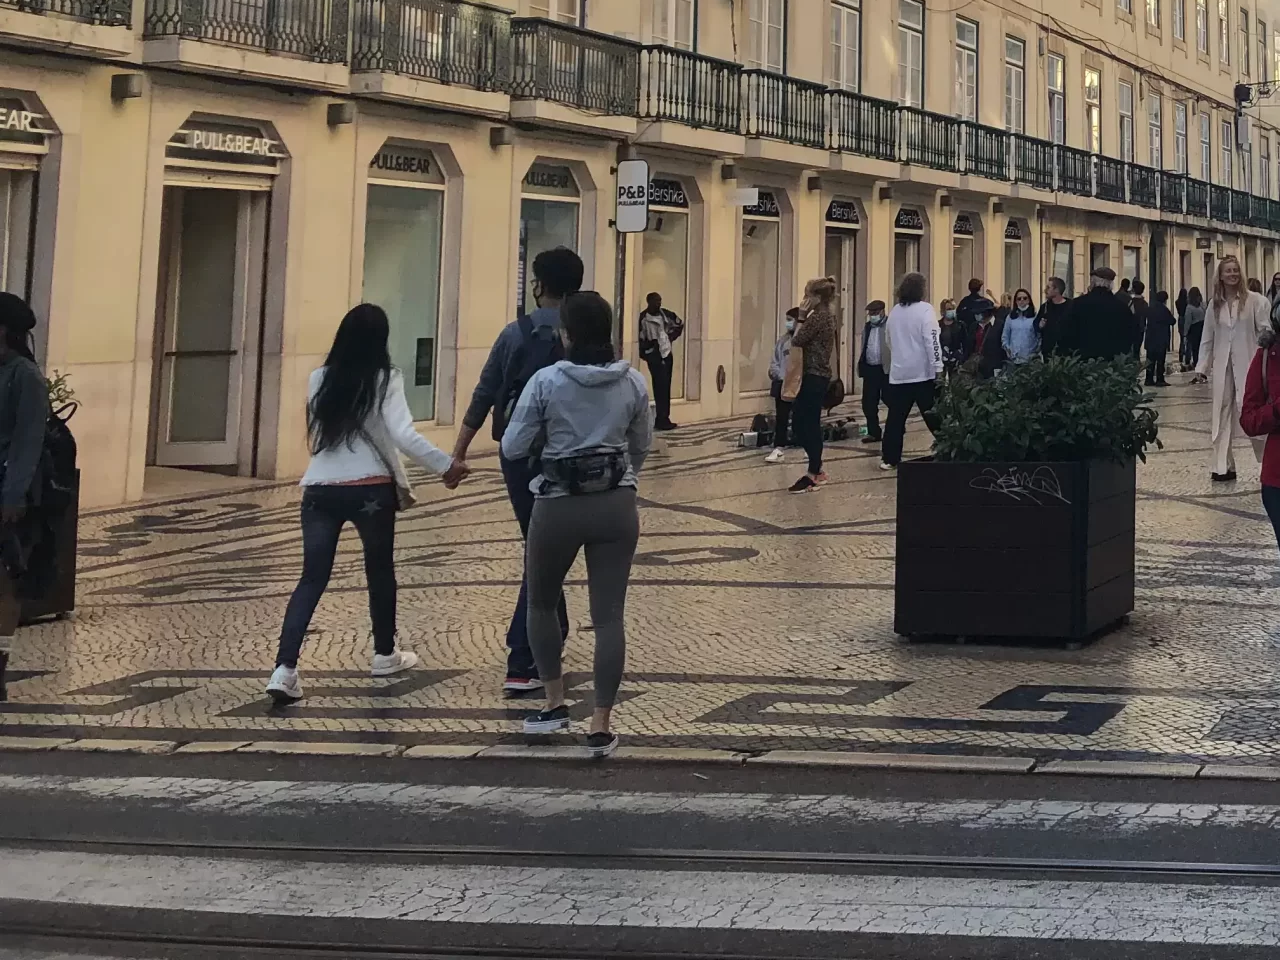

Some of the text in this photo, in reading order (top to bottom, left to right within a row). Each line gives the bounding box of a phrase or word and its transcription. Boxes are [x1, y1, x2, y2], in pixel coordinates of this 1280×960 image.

[193, 130, 269, 156] PULL&BEAR
[370, 153, 430, 175] PULL&BEAR
[618, 185, 646, 200] P&B
[649, 182, 684, 204] Bershka
